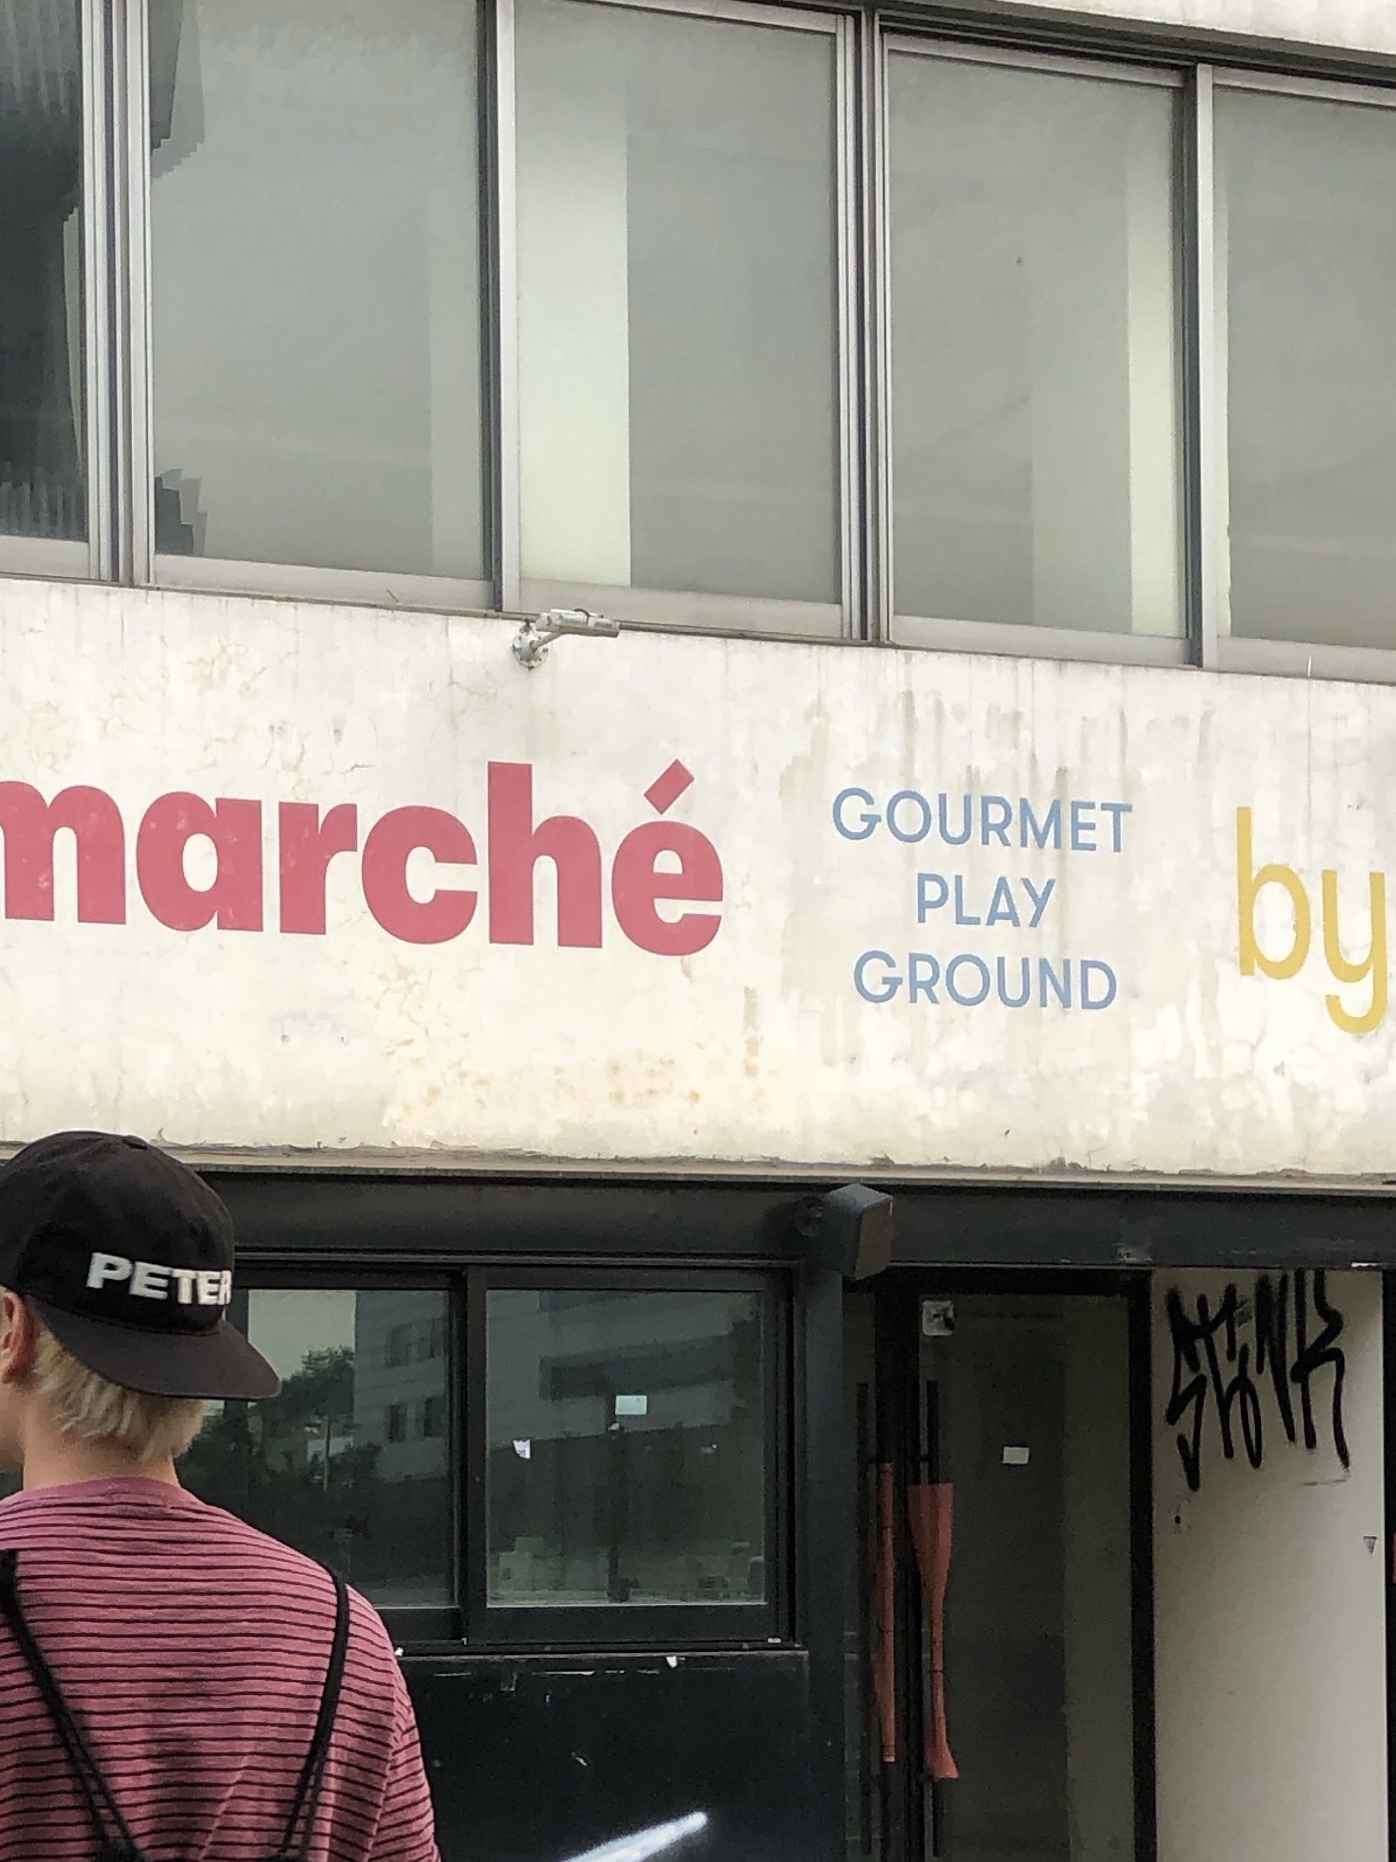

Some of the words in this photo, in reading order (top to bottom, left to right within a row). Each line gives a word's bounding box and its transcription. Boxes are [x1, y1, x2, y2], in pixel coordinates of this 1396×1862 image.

[833, 788, 1132, 853] GOURMET
[917, 874, 1055, 928] PLAY
[1237, 807, 1387, 1033] by
[855, 951, 1117, 1009] GROUND
